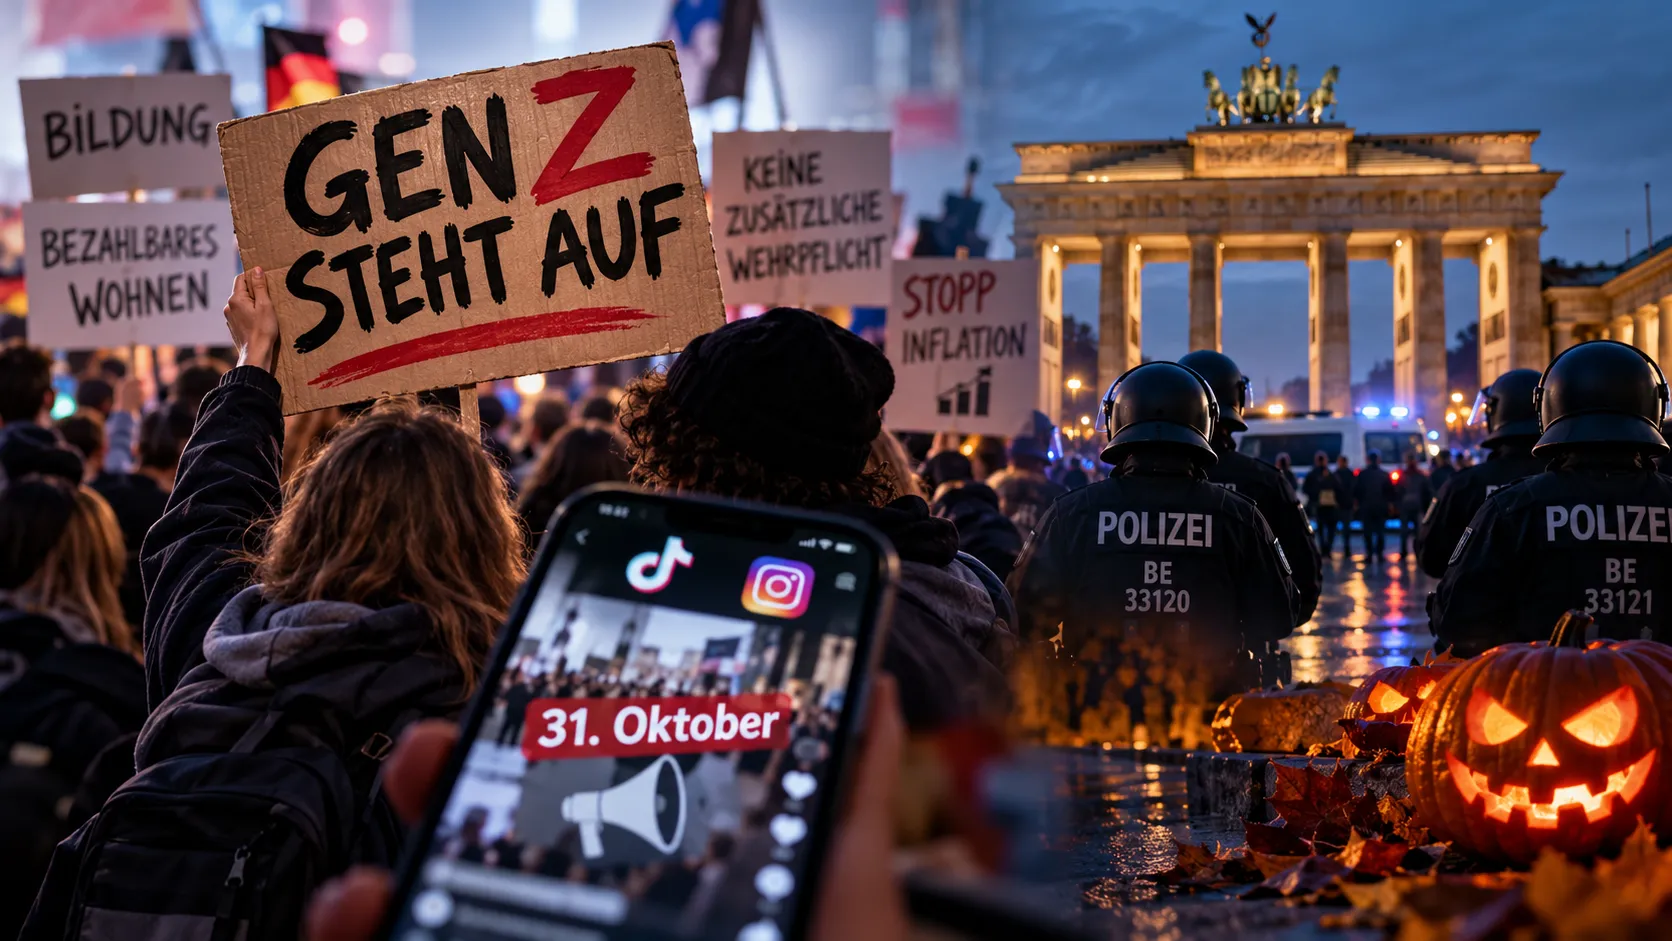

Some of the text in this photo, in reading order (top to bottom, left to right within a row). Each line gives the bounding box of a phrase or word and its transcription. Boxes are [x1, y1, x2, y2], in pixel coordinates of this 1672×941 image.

[283, 65, 656, 237] GEN Z
[725, 190, 884, 236] ZUSÄTZLICHE
[40, 222, 220, 270] BEZAHLBARES
[285, 182, 685, 354] STEHT AUF
[726, 234, 888, 284] WEHRPFLICHT
[68, 269, 210, 328] WOHNEN
[902, 270, 997, 320] STOPP
[901, 322, 1027, 366] INFLATION
[1097, 510, 1213, 548] POLIZEI
[1144, 560, 1173, 585] BE
[1605, 557, 1637, 584] BE
[1124, 588, 1190, 614] 33120
[1584, 588, 1653, 615] 33121
[537, 702, 781, 748] 31. Oktober
